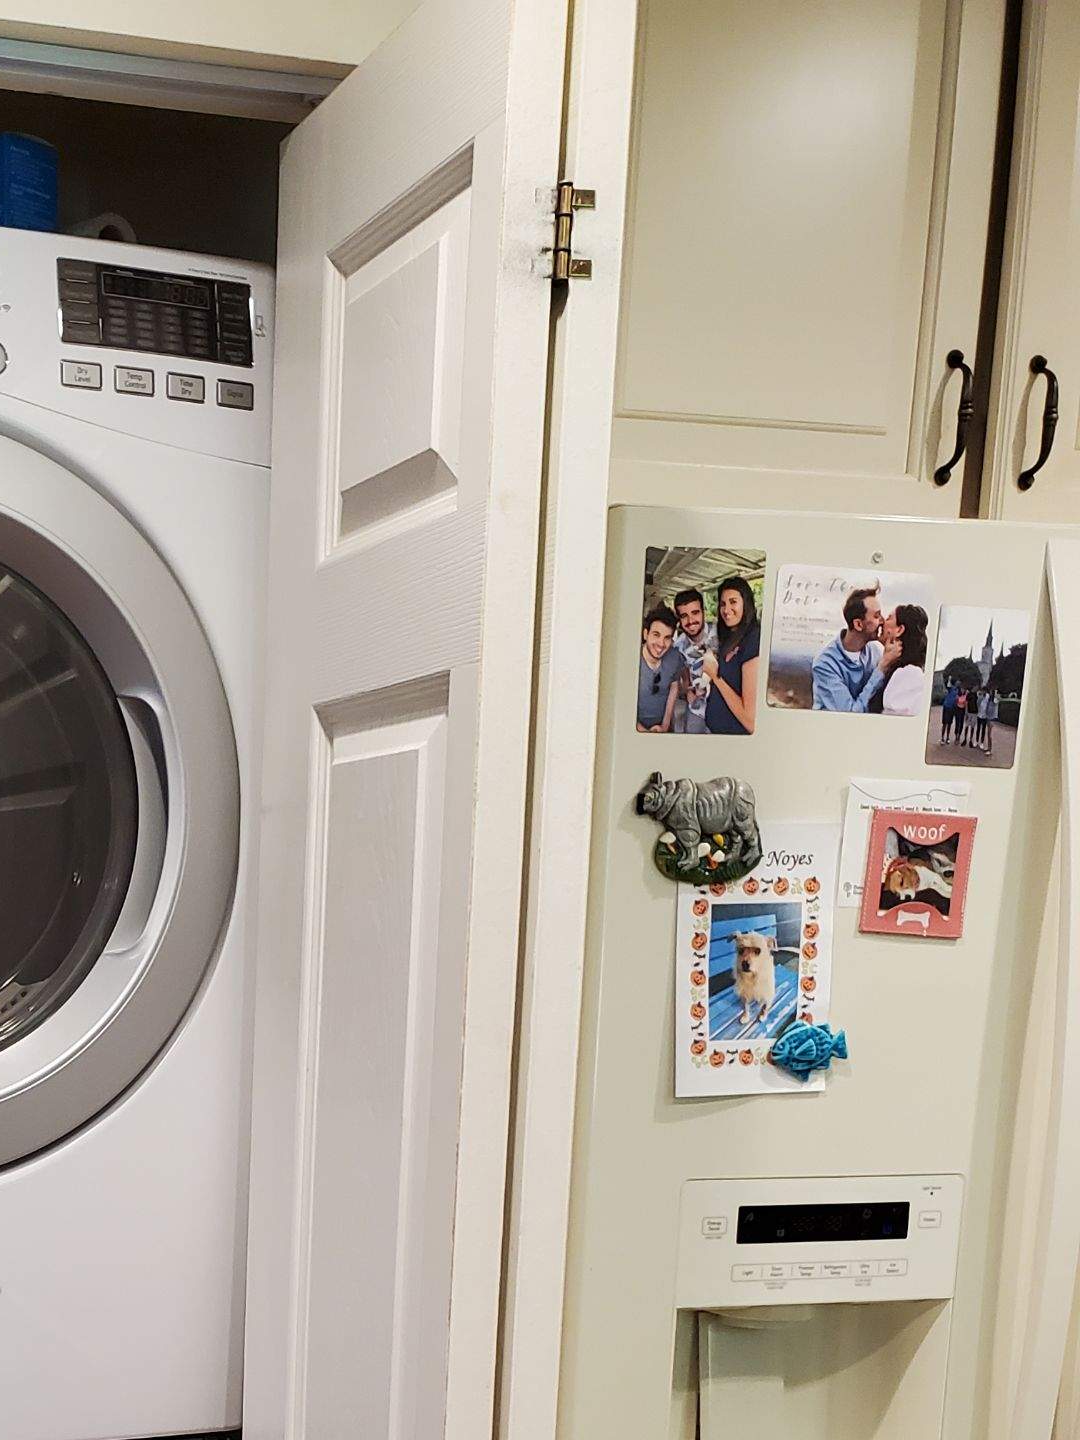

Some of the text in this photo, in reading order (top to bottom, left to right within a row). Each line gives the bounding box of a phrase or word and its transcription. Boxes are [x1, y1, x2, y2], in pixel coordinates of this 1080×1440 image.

[76, 366, 88, 375] Dry
[73, 375, 92, 384] Level
[126, 371, 143, 381] Temp
[124, 380, 147, 389] Control
[180, 379, 194, 387] Time
[181, 387, 192, 396] Dry
[766, 850, 814, 871] Noyes
